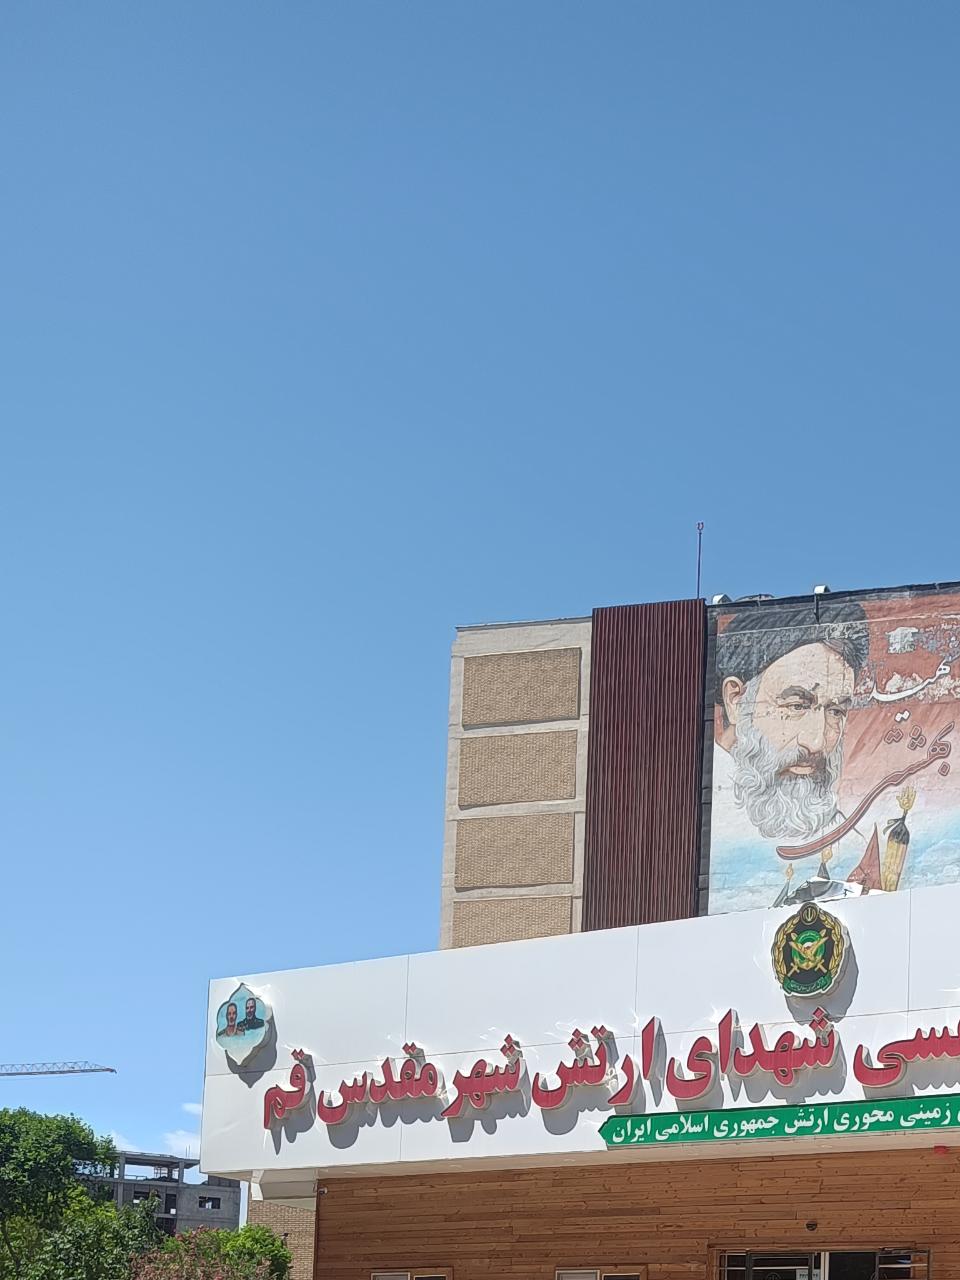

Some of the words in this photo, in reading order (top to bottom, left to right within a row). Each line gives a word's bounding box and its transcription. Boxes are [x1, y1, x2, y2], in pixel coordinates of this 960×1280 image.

[776, 721, 955, 860] بهشتی
[440, 1032, 522, 1118] شهر
[531, 1022, 656, 1108] ارتش
[666, 1006, 836, 1100] شهدای
[263, 1047, 307, 1131] قم
[317, 1042, 439, 1125] مقدس
[612, 1118, 652, 1144] ایران
[655, 1114, 710, 1142] اسلامی
[713, 1114, 780, 1138] جمهوری
[784, 1107, 829, 1134] ارتش
[833, 1108, 895, 1133] محوری
[899, 1103, 951, 1128] زمینی
